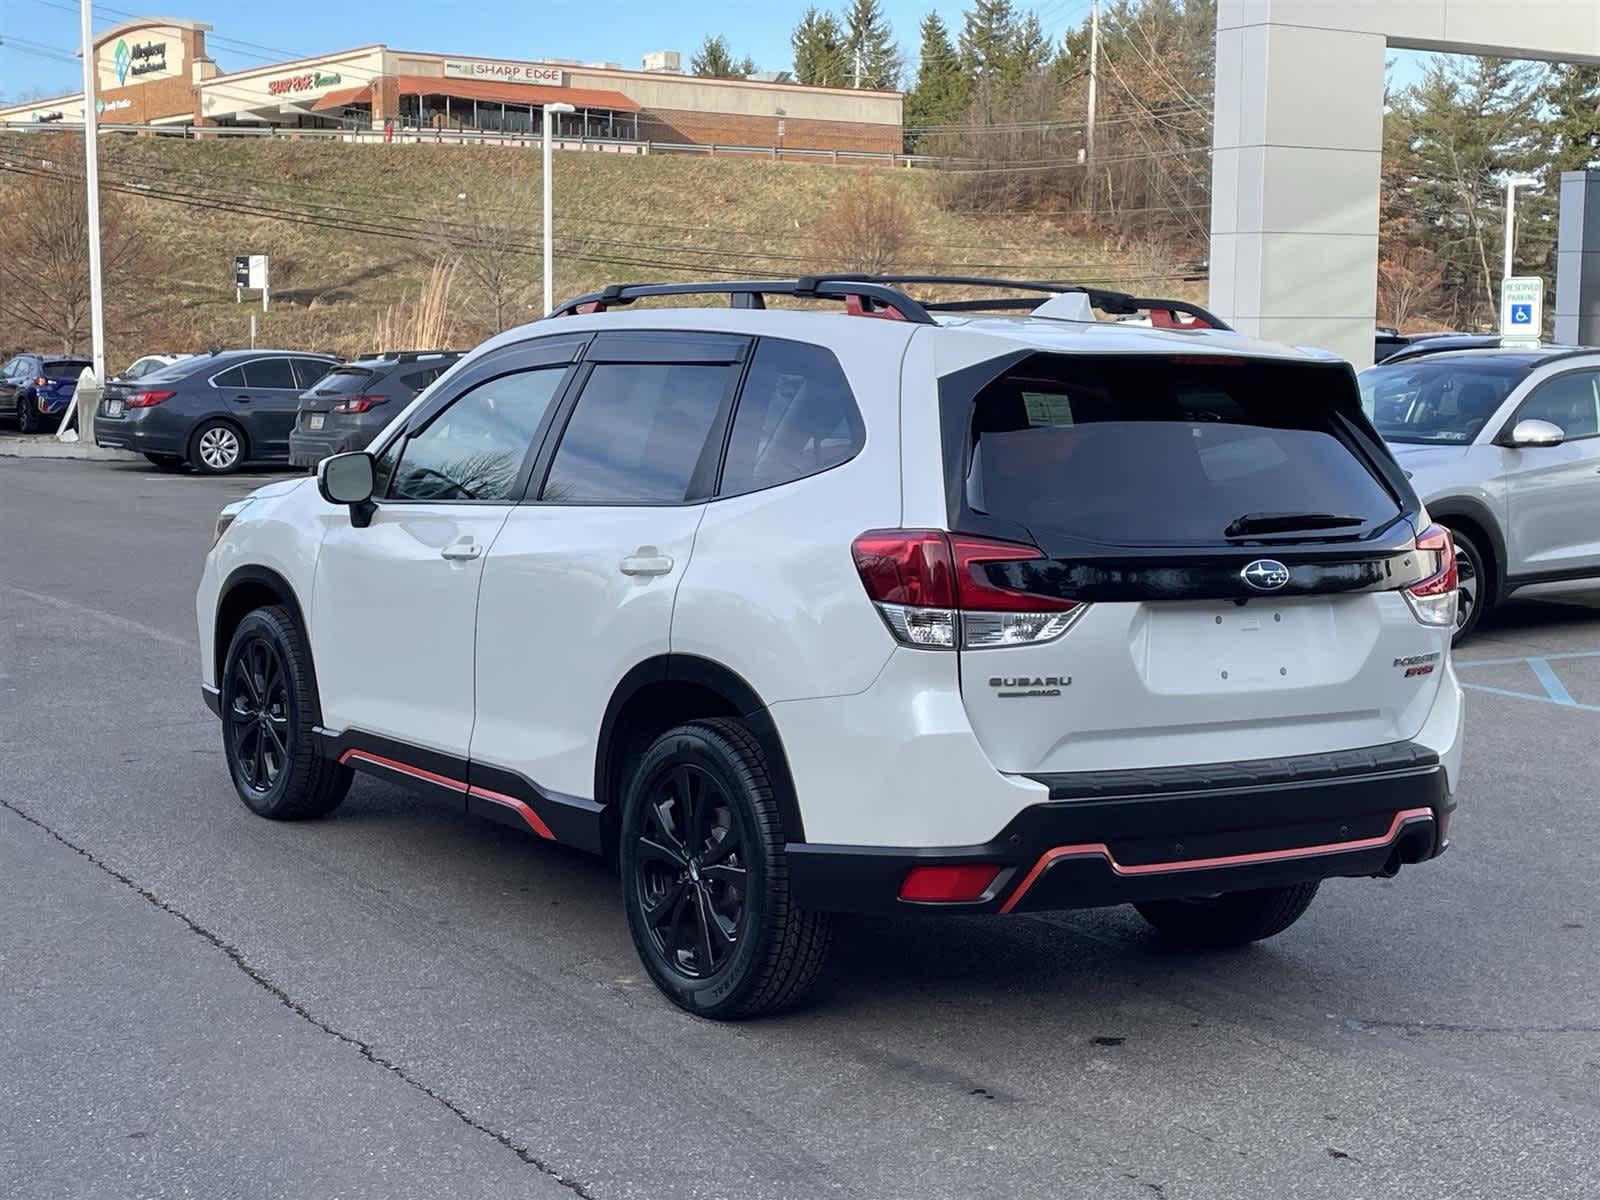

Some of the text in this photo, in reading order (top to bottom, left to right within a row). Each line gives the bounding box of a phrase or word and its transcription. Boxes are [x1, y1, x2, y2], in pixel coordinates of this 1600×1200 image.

[475, 64, 520, 76] SHARP
[525, 68, 560, 80] EDGE
[989, 676, 1072, 687] SUBARU
